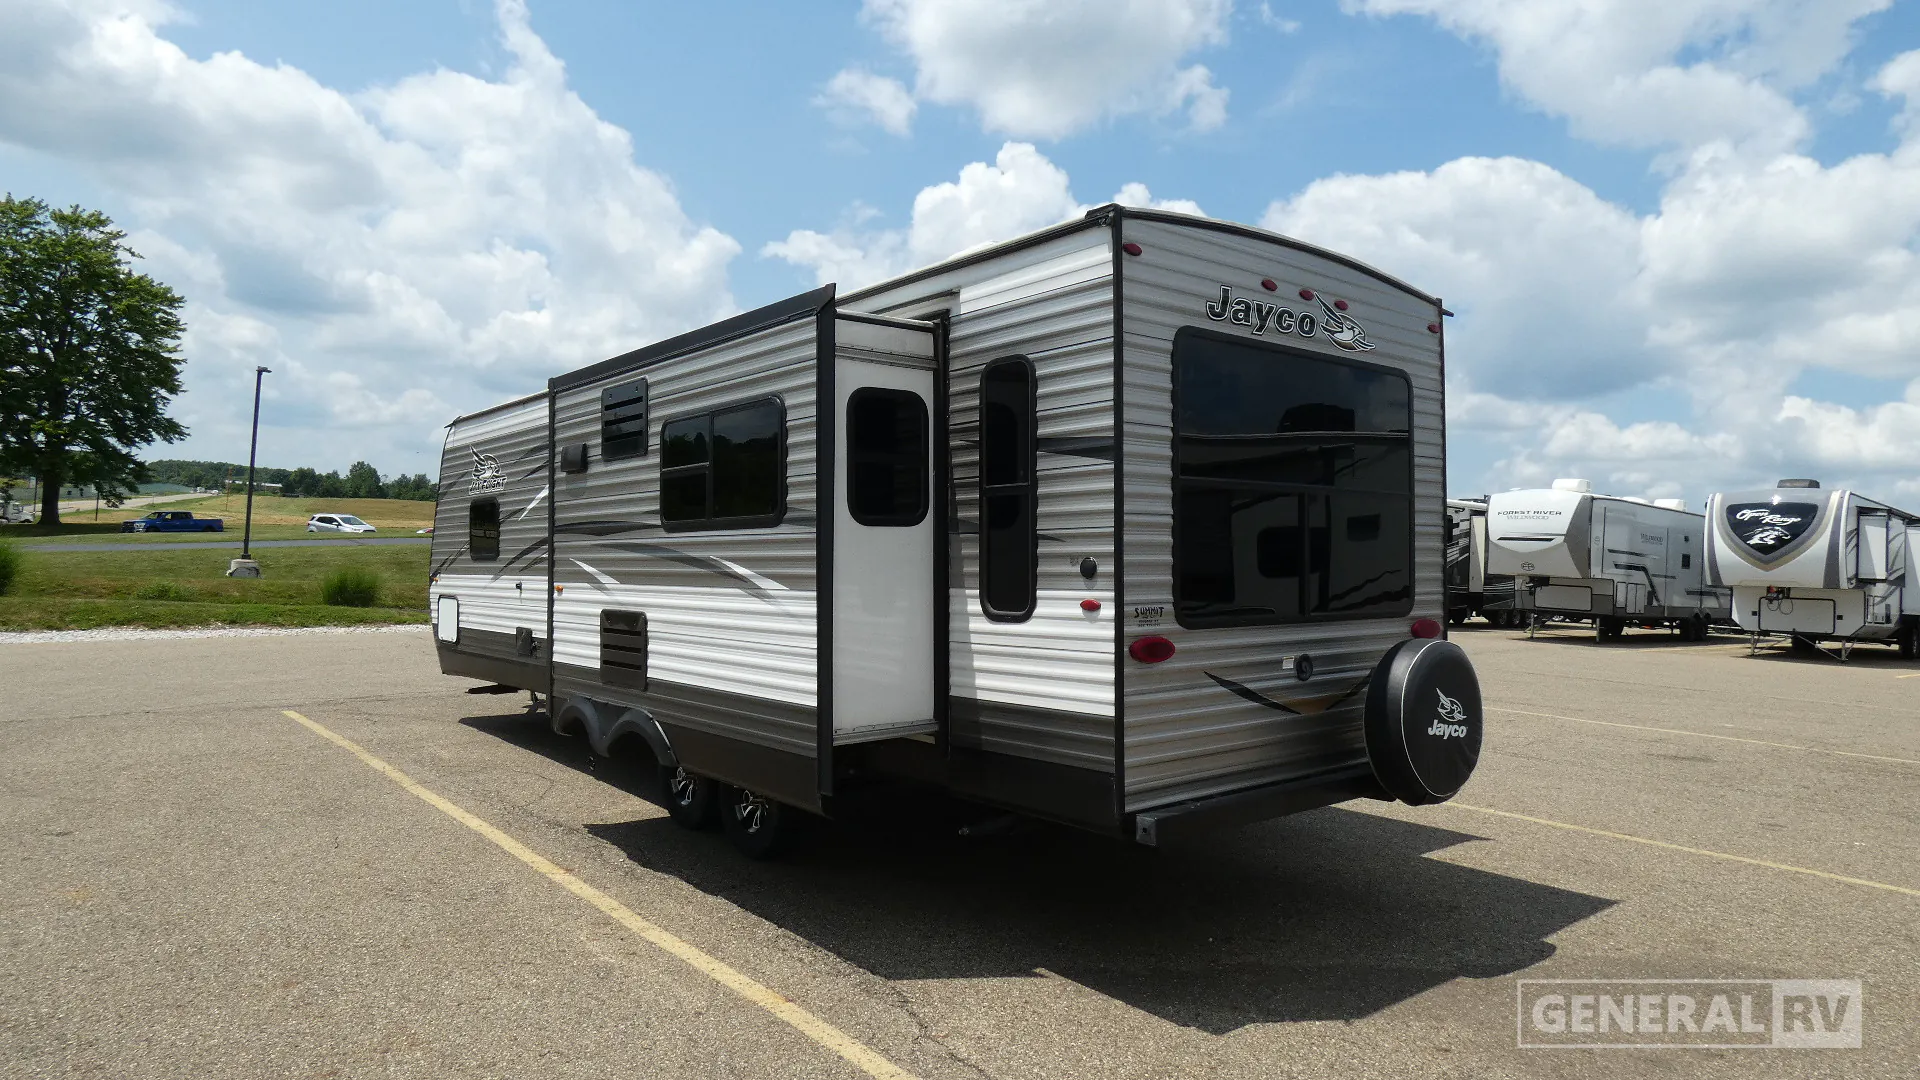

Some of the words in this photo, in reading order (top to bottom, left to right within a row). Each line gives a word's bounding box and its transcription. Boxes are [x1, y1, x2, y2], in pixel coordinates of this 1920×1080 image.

[1205, 284, 1318, 338] Jayco
[1736, 509, 1770, 521] Open
[1759, 514, 1802, 526] Range
[1134, 606, 1165, 618] SUMMIT
[1427, 719, 1467, 740] Jayco
